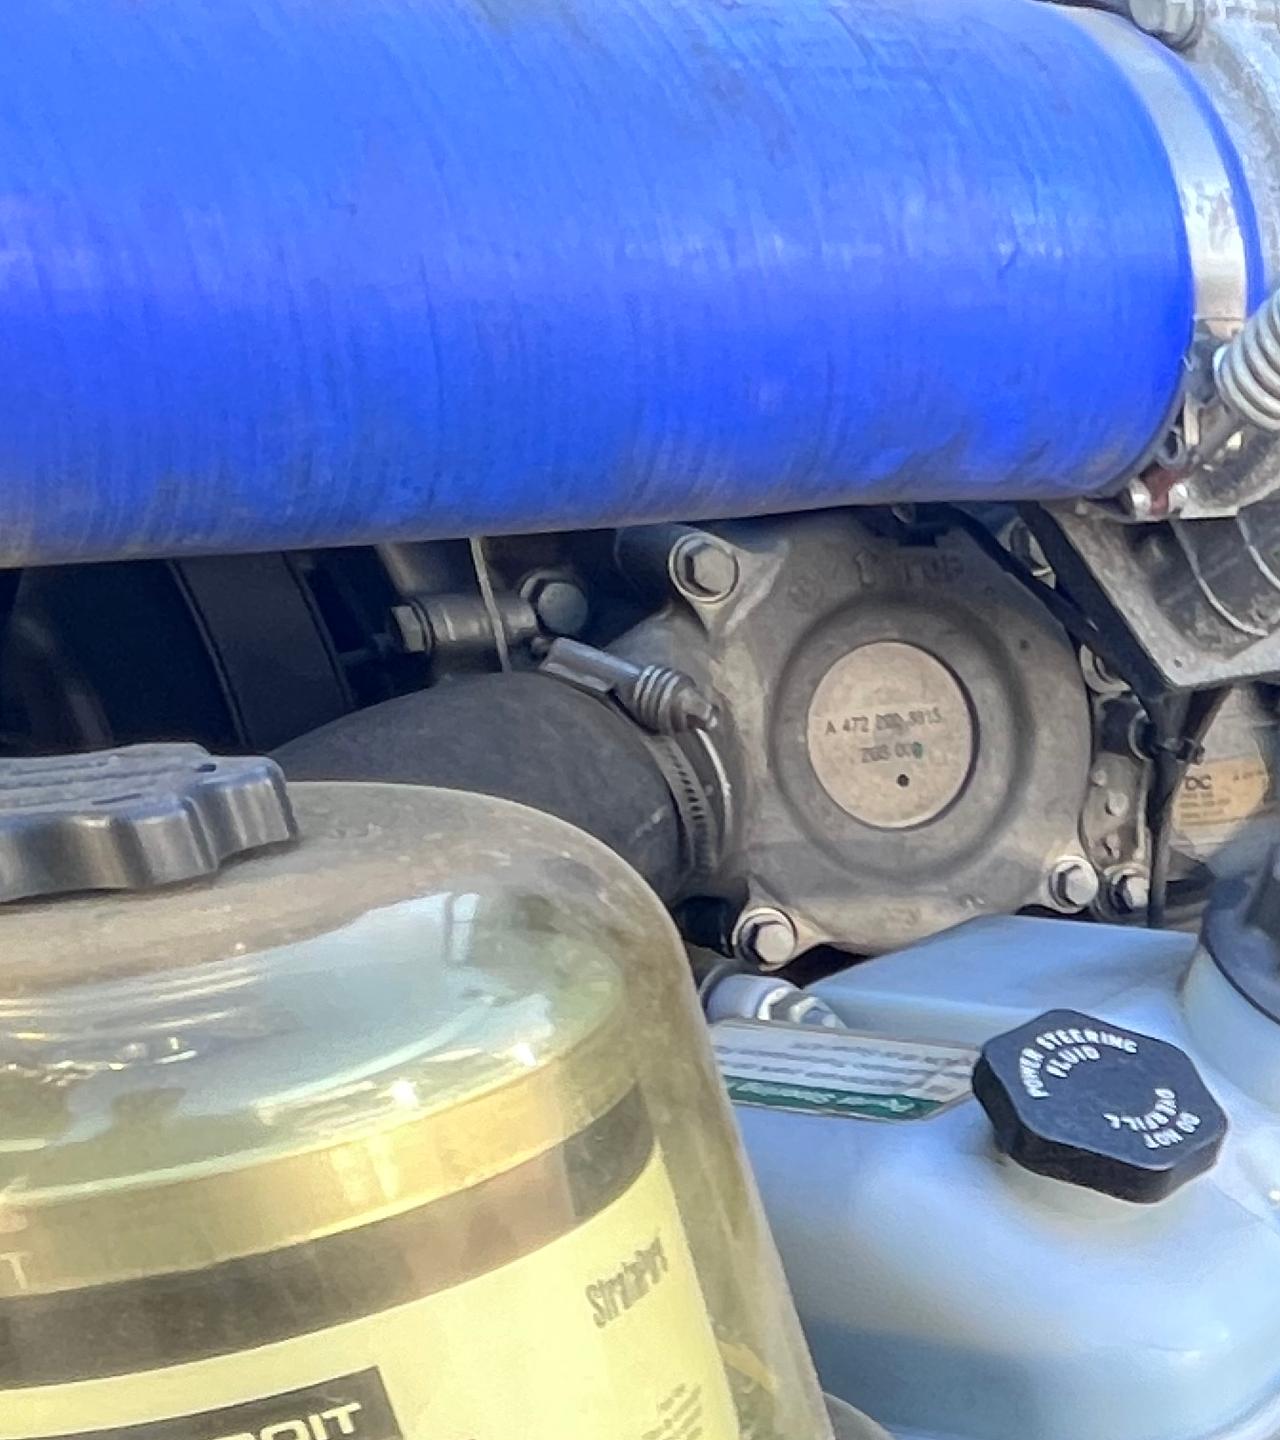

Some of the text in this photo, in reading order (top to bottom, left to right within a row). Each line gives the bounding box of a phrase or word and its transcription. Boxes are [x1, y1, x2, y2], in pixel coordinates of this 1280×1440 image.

[1019, 1047, 1051, 1097] POWER
[1036, 1028, 1138, 1054] STEERING
[1046, 1044, 1101, 1079] FLUID
